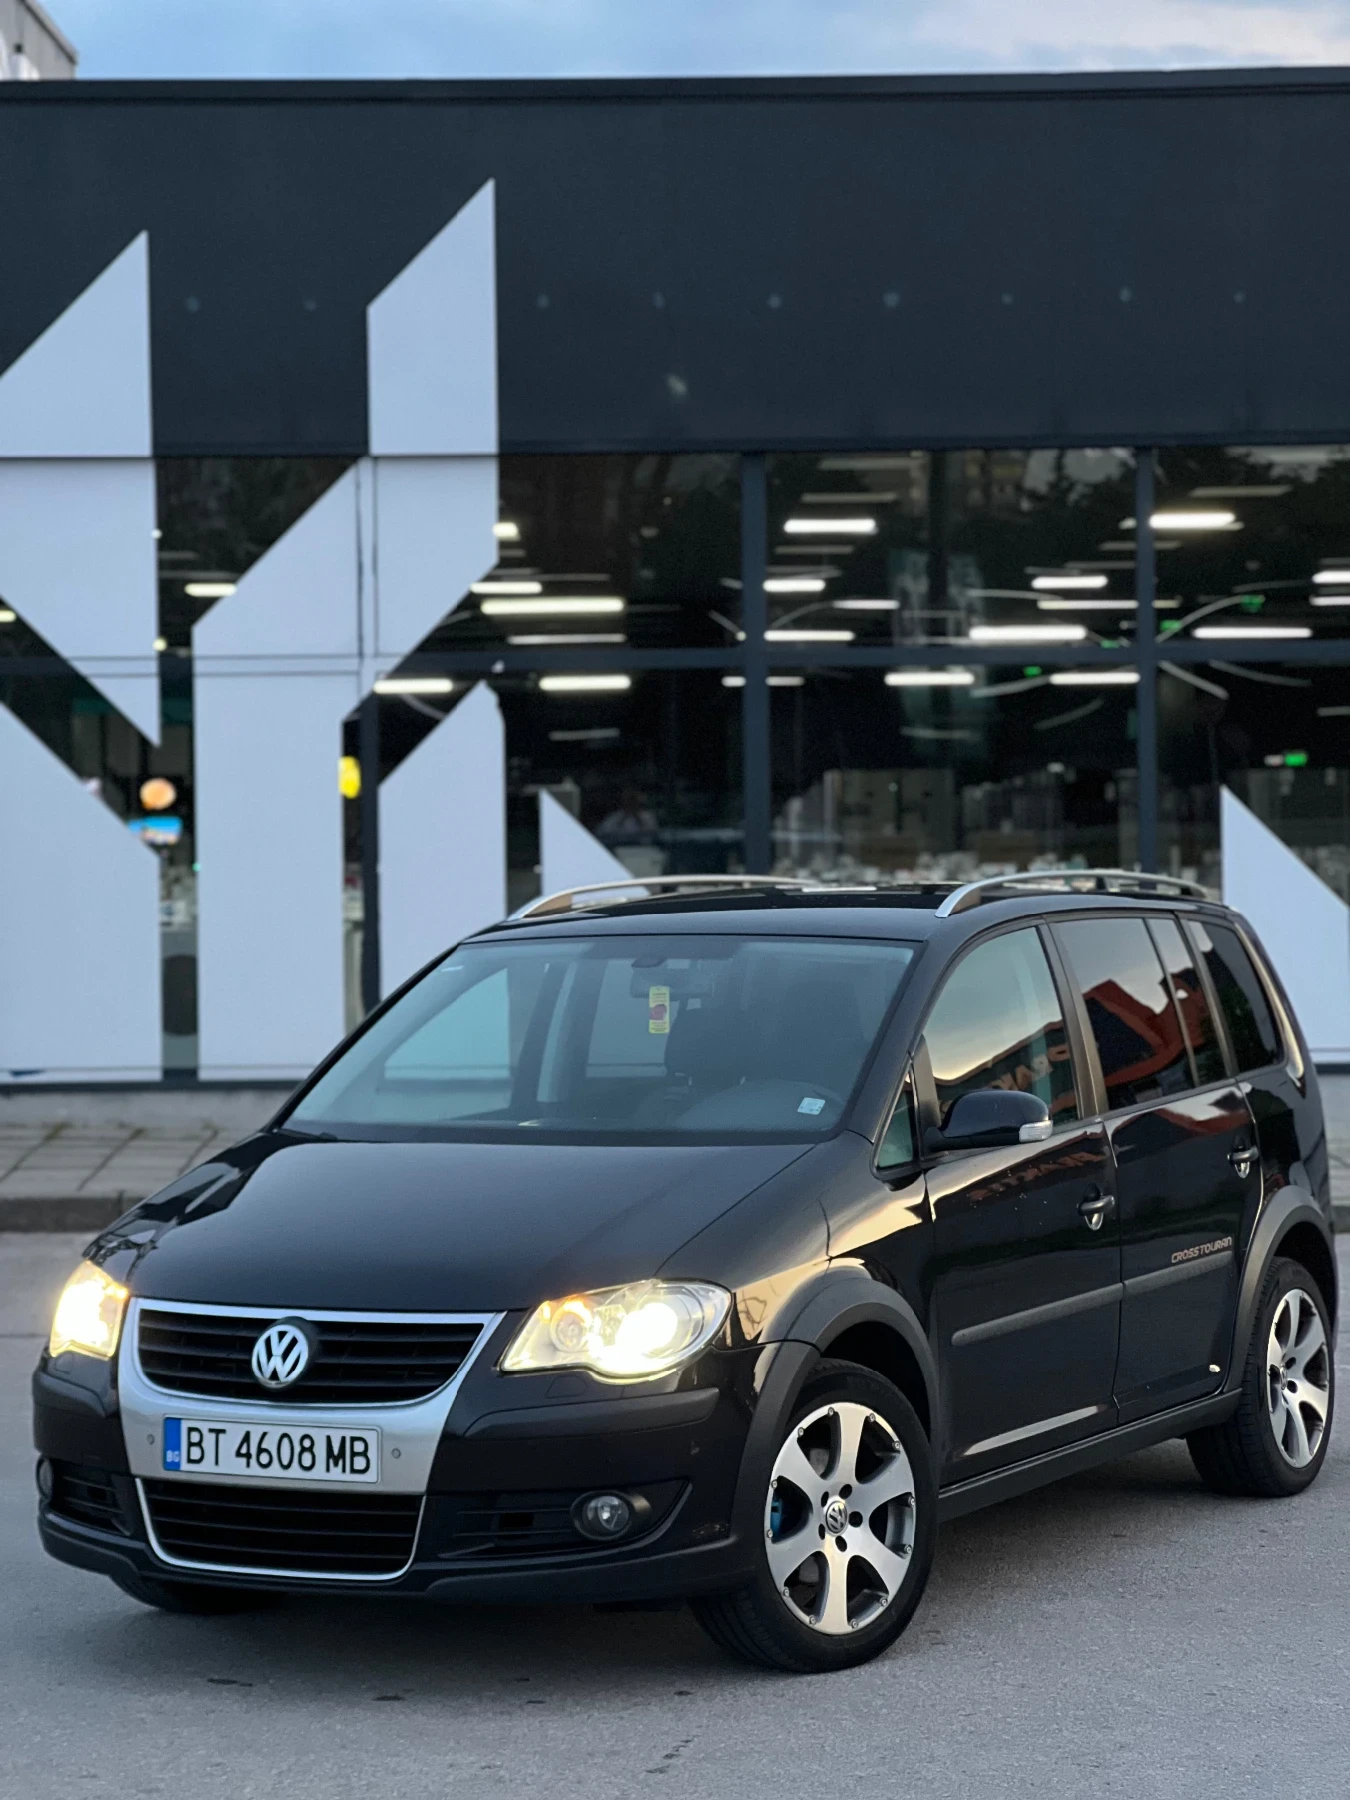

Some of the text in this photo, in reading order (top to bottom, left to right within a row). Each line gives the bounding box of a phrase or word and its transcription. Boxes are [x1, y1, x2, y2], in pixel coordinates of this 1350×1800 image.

[252, 1324, 308, 1387] VW
[186, 1426, 370, 1475] BT 4608 MB
